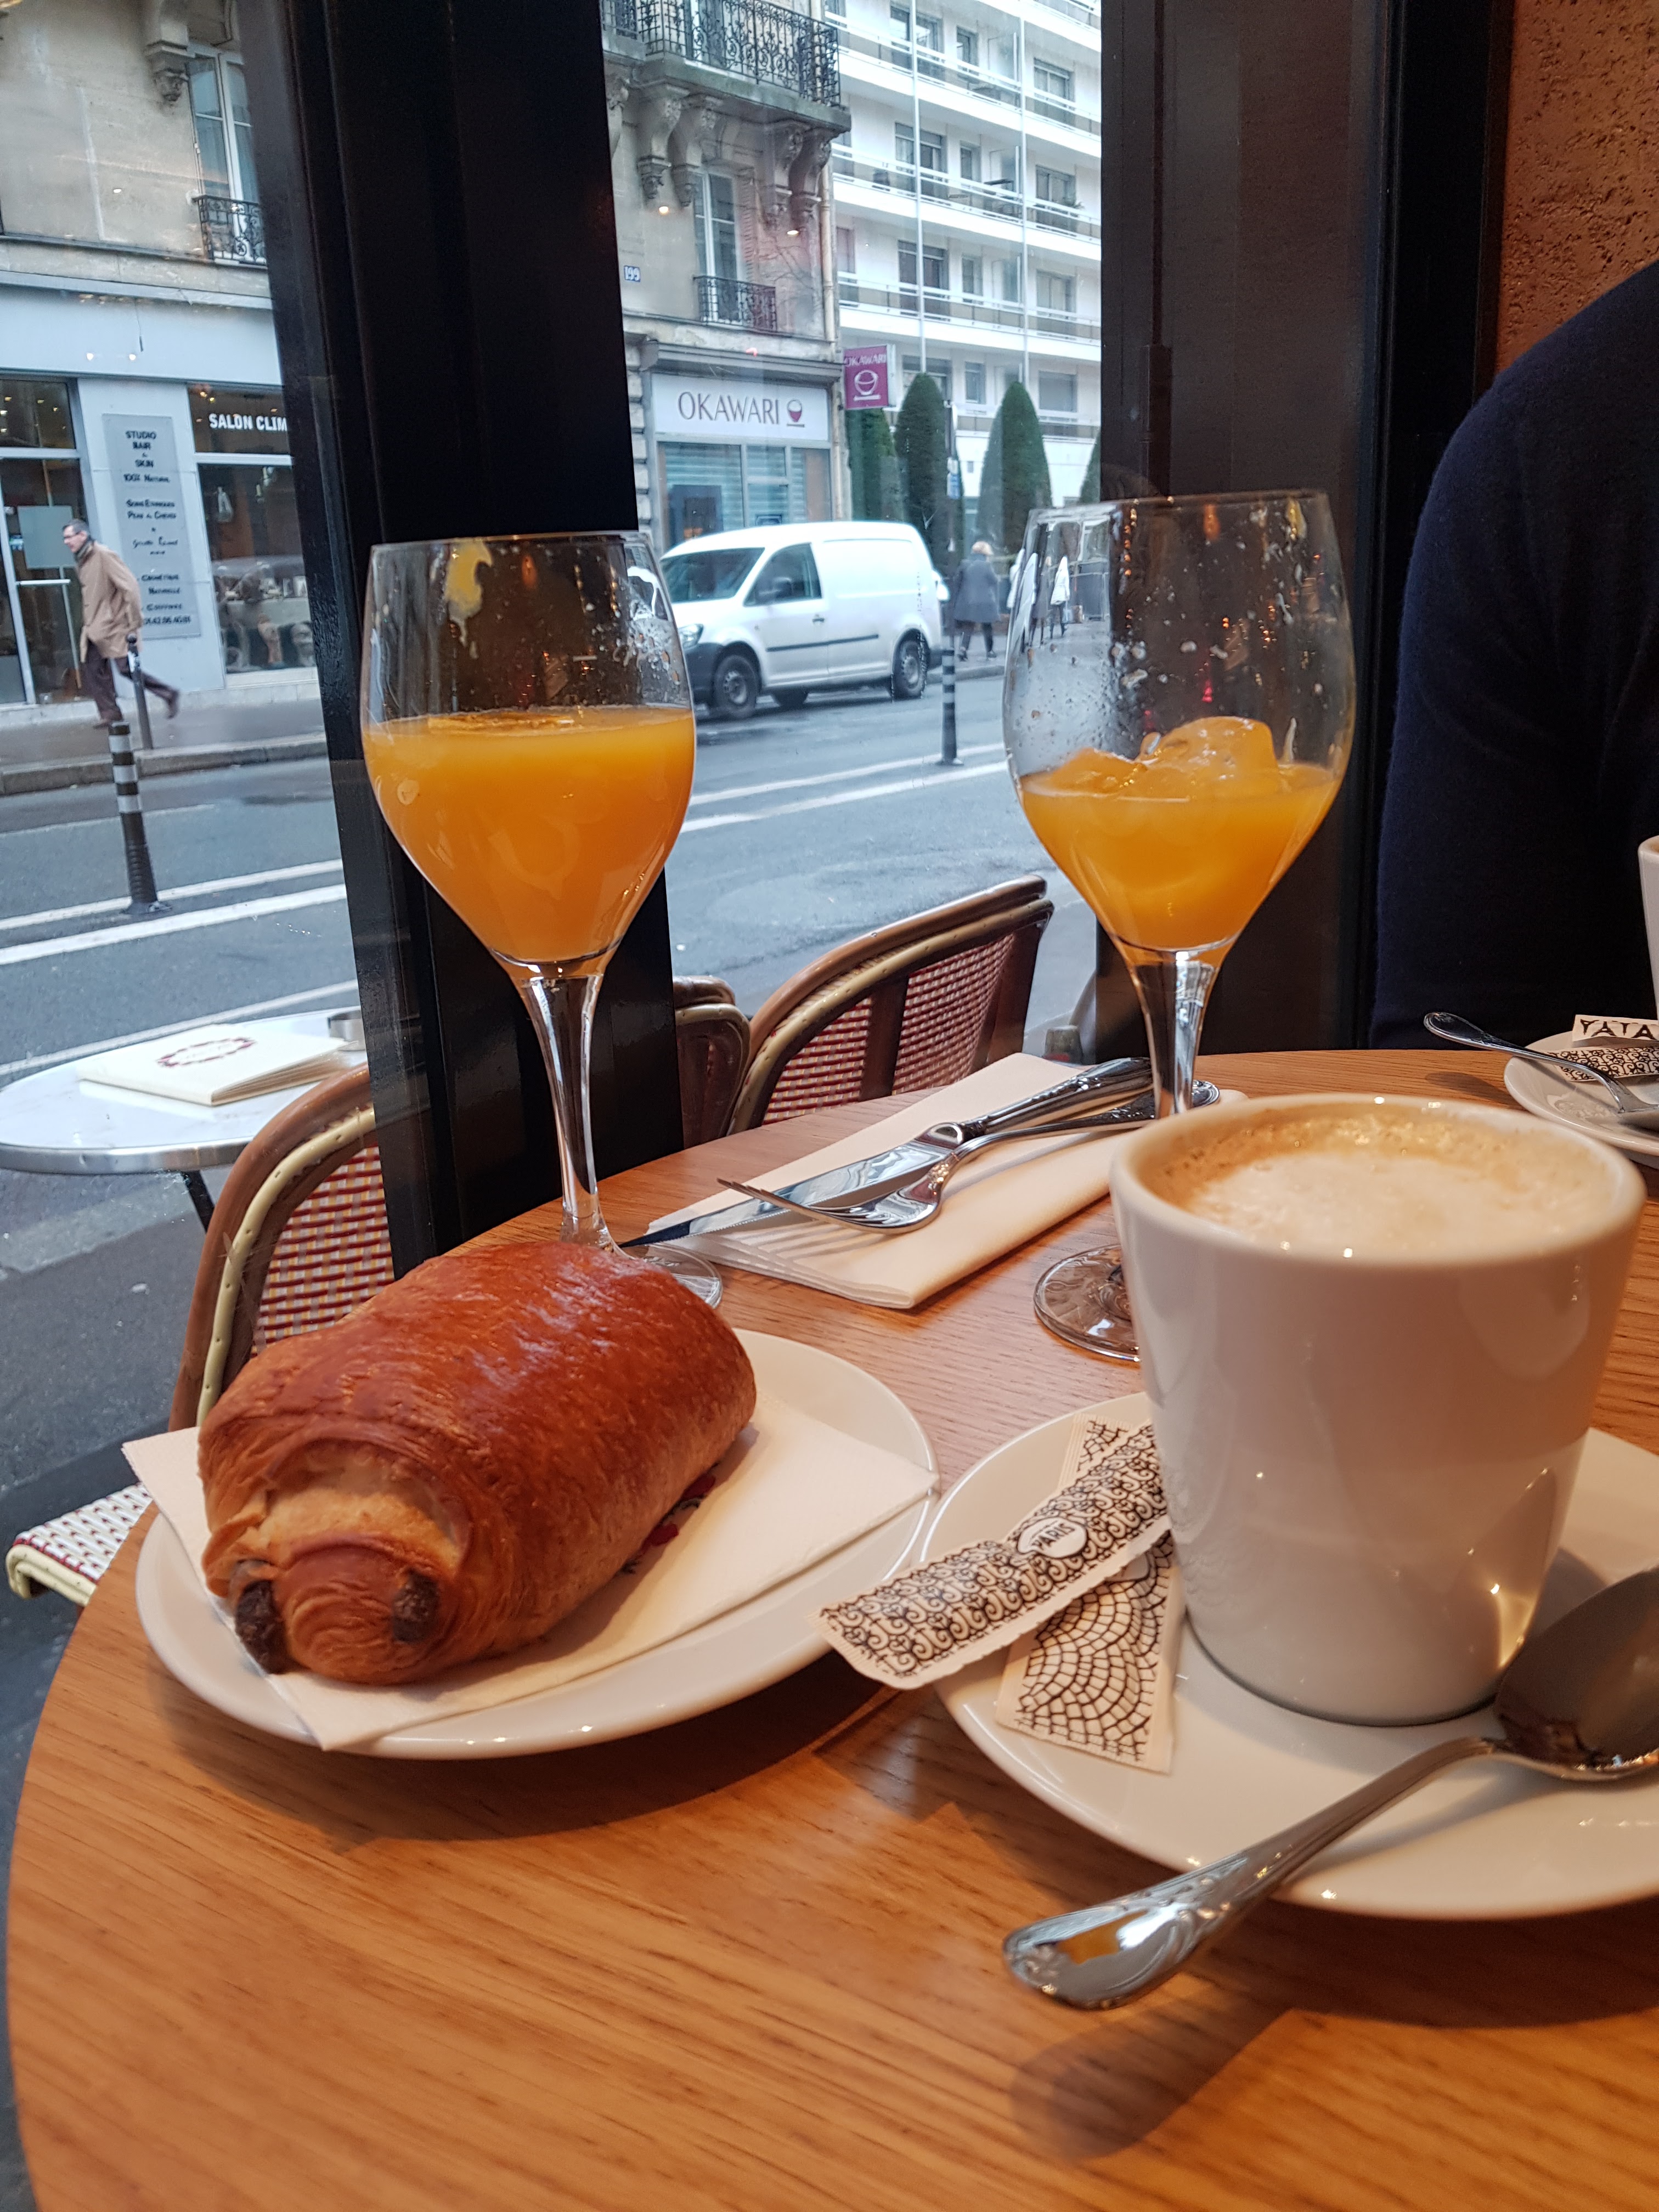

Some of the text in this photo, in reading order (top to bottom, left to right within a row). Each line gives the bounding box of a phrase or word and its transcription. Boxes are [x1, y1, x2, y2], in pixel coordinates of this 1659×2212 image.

[624, 266, 640, 281] 199
[678, 391, 780, 425] OKAWARI
[208, 413, 253, 430] SALON
[125, 430, 157, 439] STUDIO
[1031, 1522, 1075, 1551] PARIS
